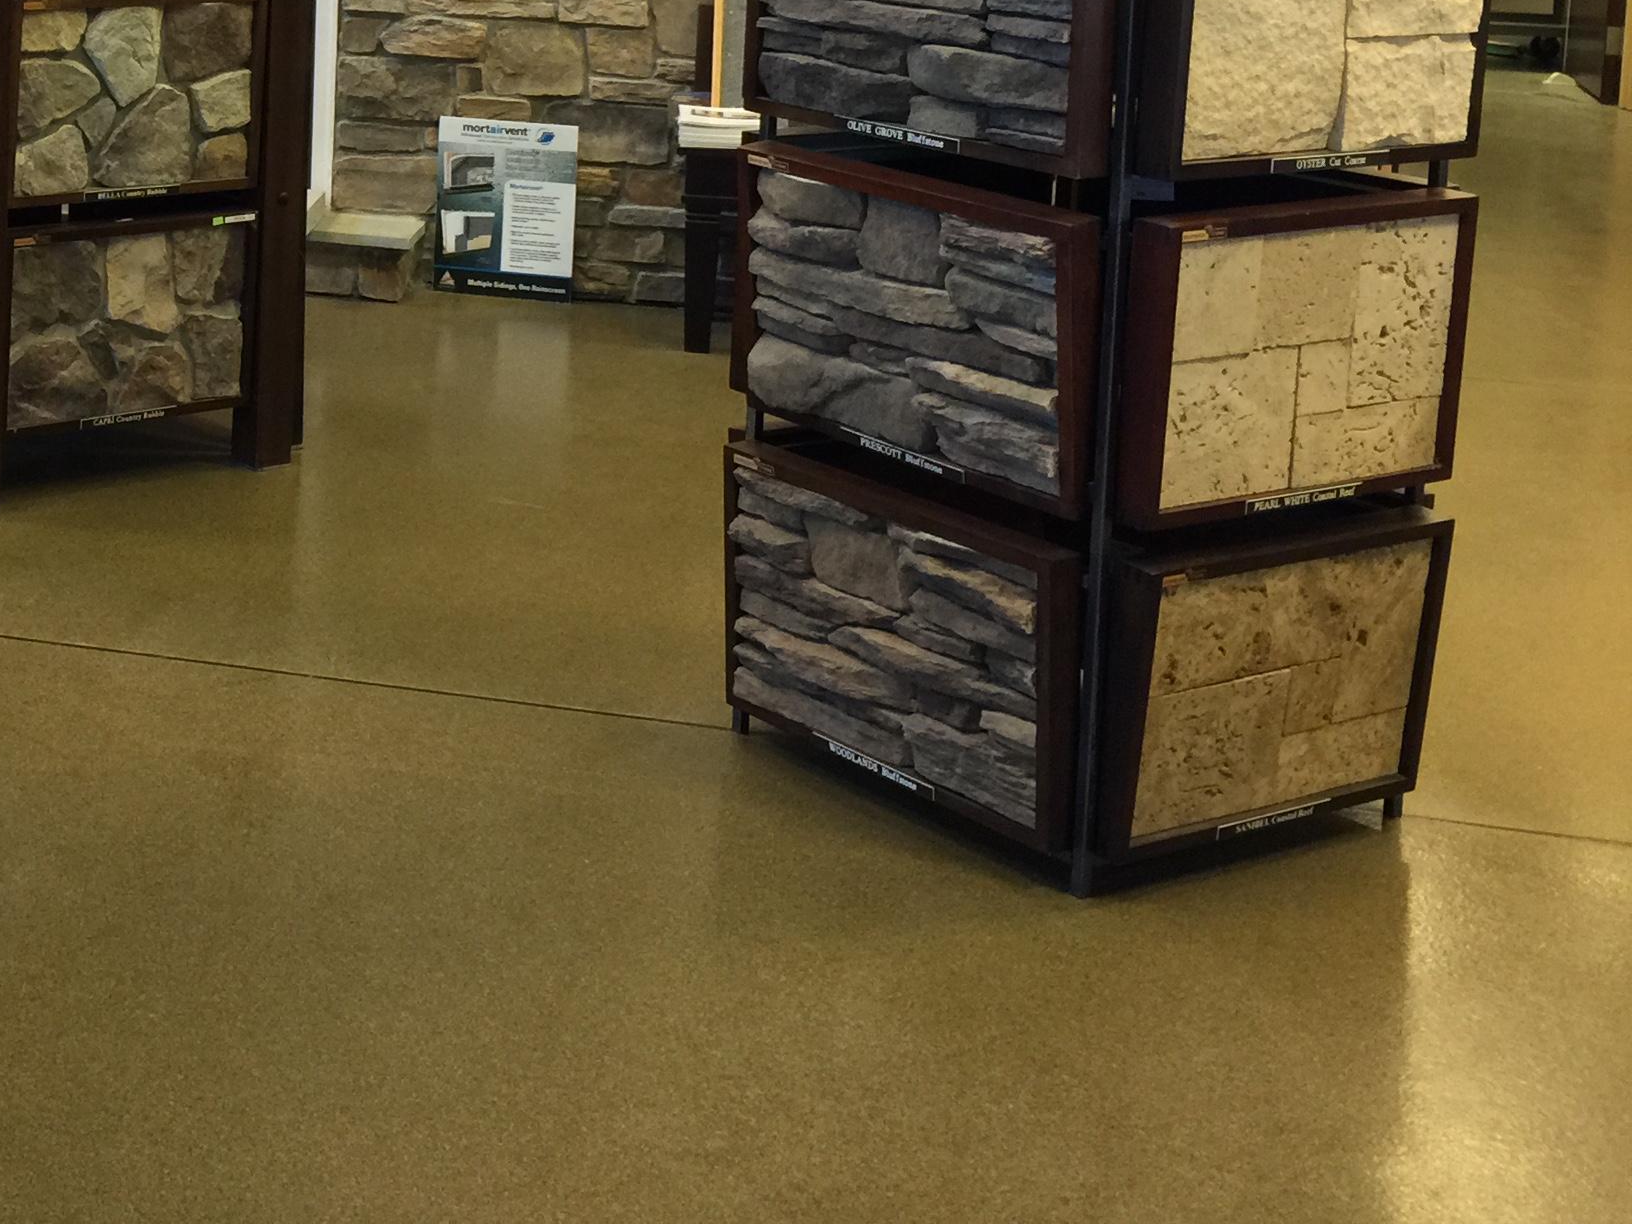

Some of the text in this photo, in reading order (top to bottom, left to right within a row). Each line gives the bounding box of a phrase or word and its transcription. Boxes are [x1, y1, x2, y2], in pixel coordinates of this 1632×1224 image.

[462, 123, 529, 136] mortairvent
[846, 120, 872, 134] OLIVE
[874, 125, 903, 140] GROVE
[1295, 157, 1327, 170] OYSTER
[860, 436, 902, 460] PRESCOTT
[1253, 498, 1282, 512] PEARL
[1283, 493, 1311, 507] WHITE
[828, 741, 879, 773] WOODLANDS
